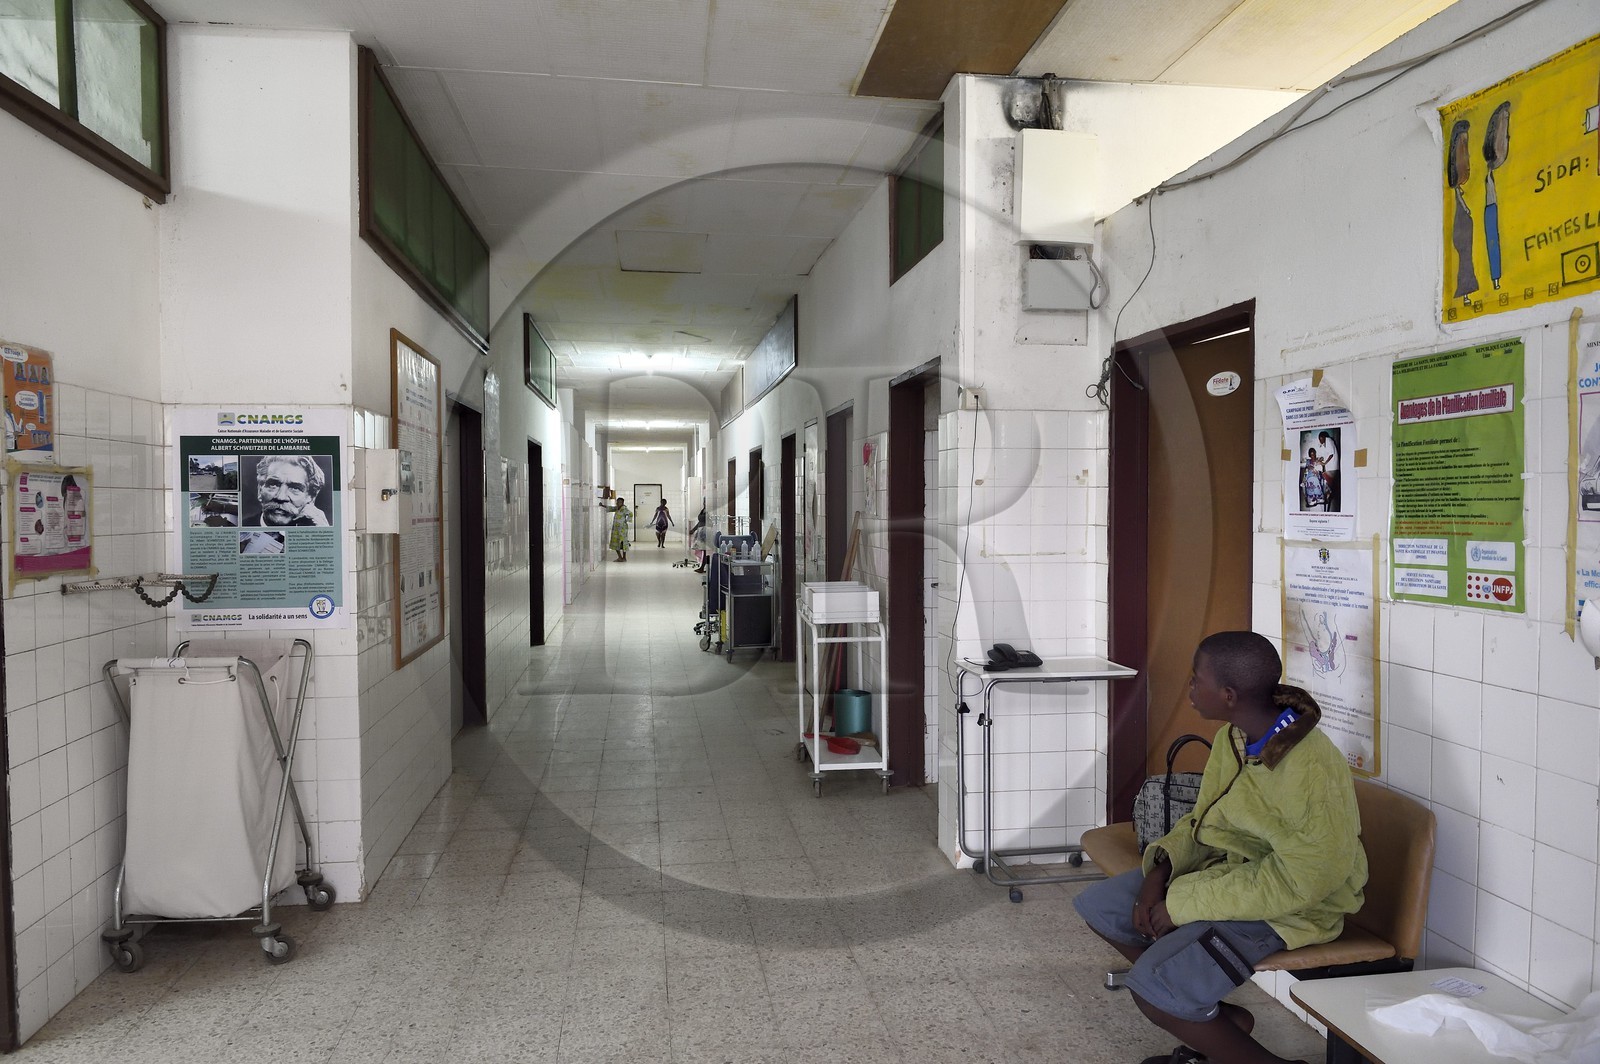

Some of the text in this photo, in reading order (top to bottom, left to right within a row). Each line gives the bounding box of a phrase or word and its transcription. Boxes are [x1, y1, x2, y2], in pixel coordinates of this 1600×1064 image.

[1400, 387, 1507, 420] Avantages de la Planification familiale
[237, 414, 304, 425] CNAMGS
[1581, 568, 1590, 576] La
